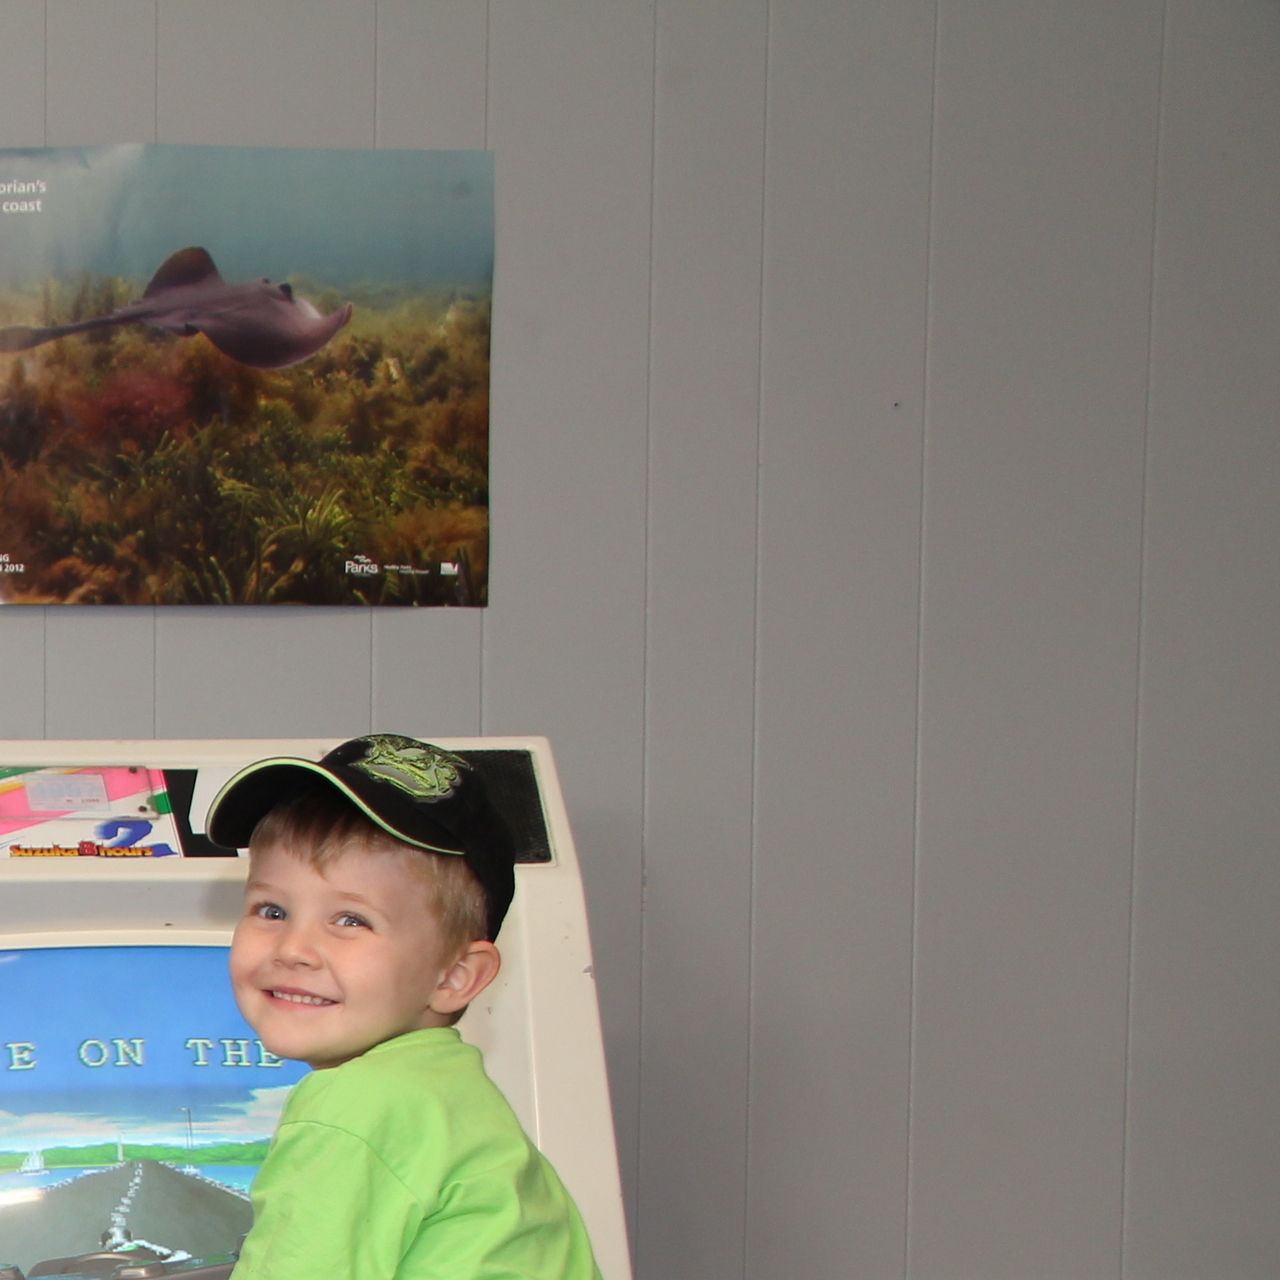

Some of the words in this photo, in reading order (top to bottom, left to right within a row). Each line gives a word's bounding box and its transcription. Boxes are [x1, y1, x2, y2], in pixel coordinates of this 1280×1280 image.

[2, 200, 42, 212] coast
[4, 563, 25, 573] 2012
[345, 561, 378, 574] Parks
[9, 843, 79, 857] Suzuka
[99, 843, 153, 857] hours
[79, 1038, 147, 1068] ON
[185, 1038, 284, 1068] THE
